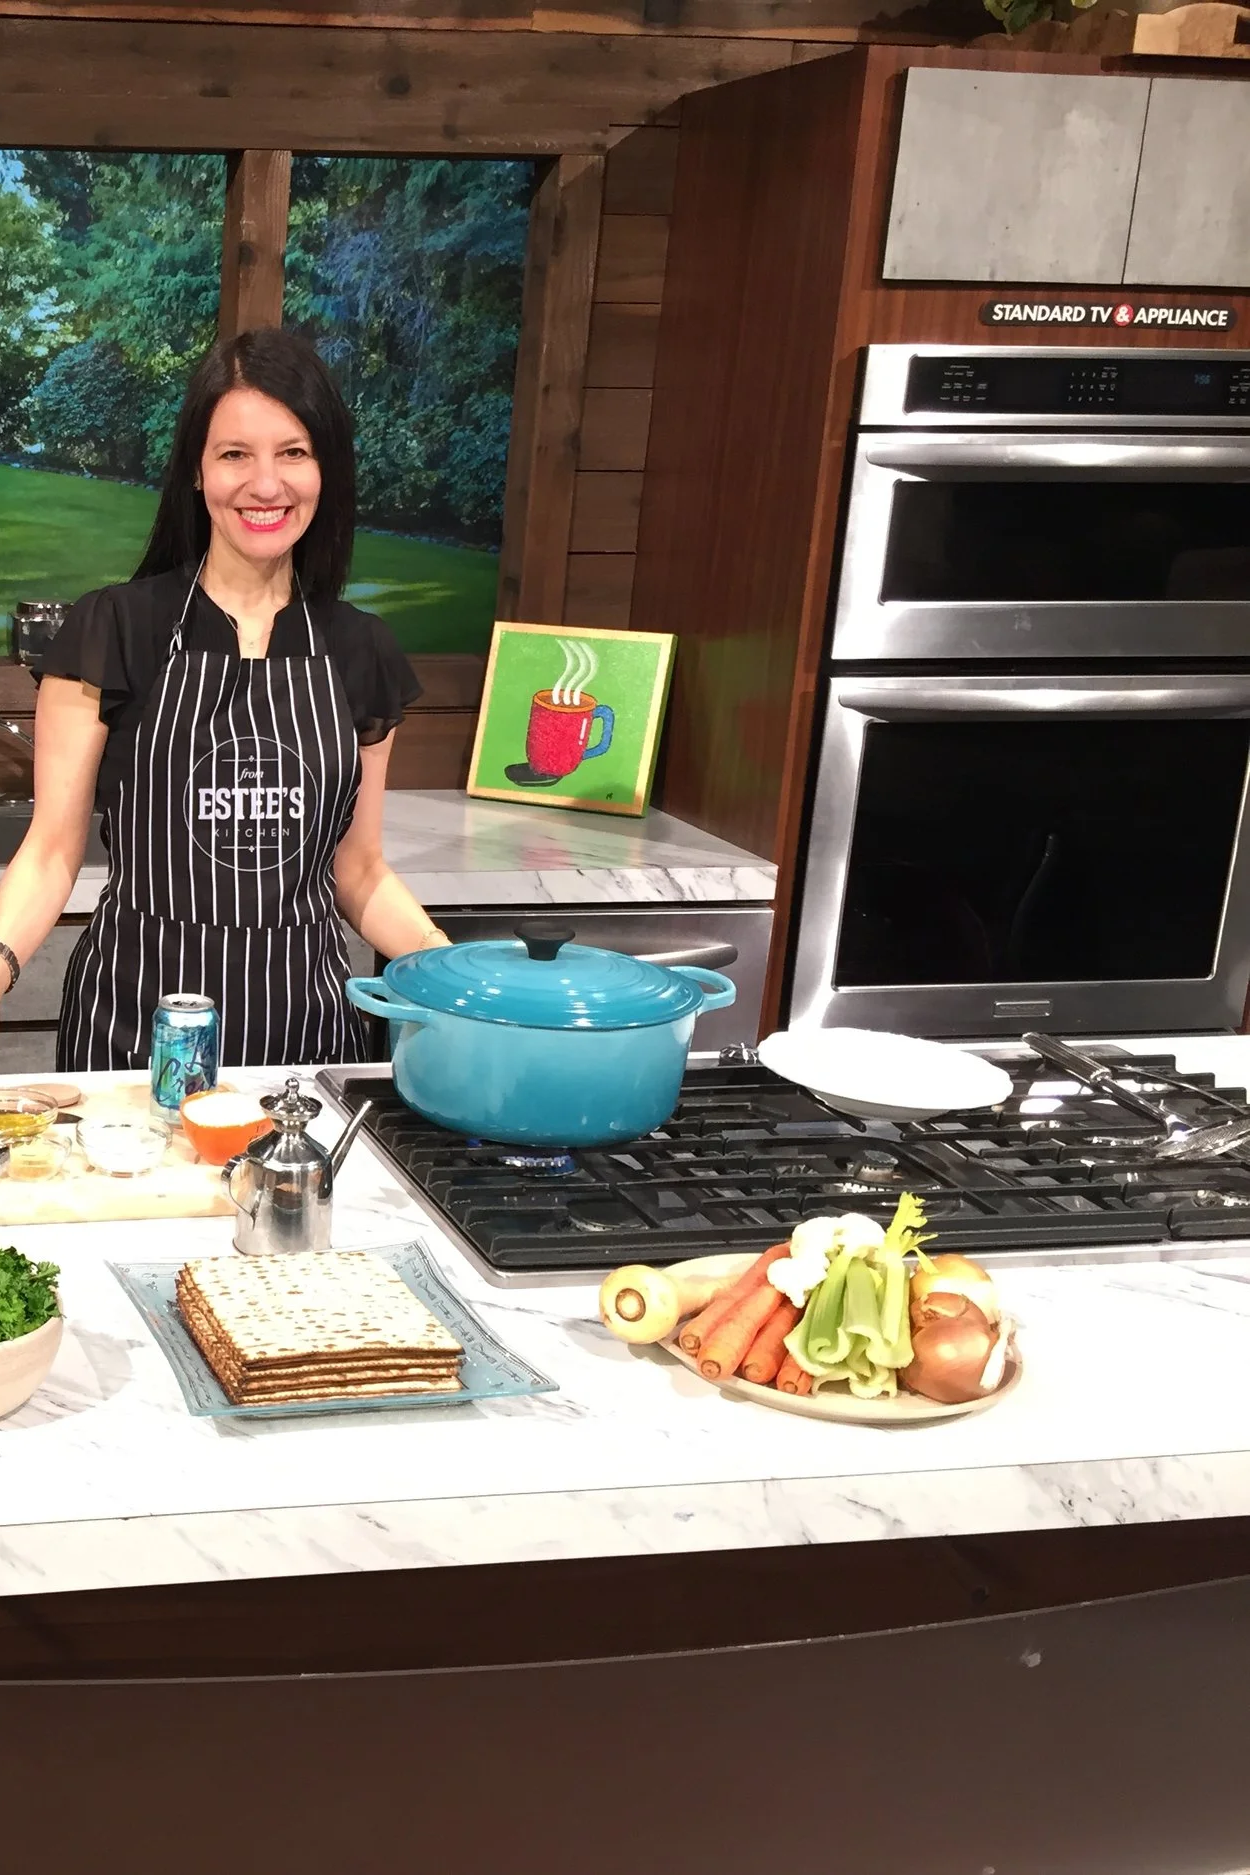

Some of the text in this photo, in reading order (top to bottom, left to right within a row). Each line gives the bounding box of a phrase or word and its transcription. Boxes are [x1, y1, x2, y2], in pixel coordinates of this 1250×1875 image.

[992, 304, 1229, 326] STANDARD TV & APPLIANCE
[238, 768, 264, 782] from
[197, 786, 306, 820] ESTEE'S
